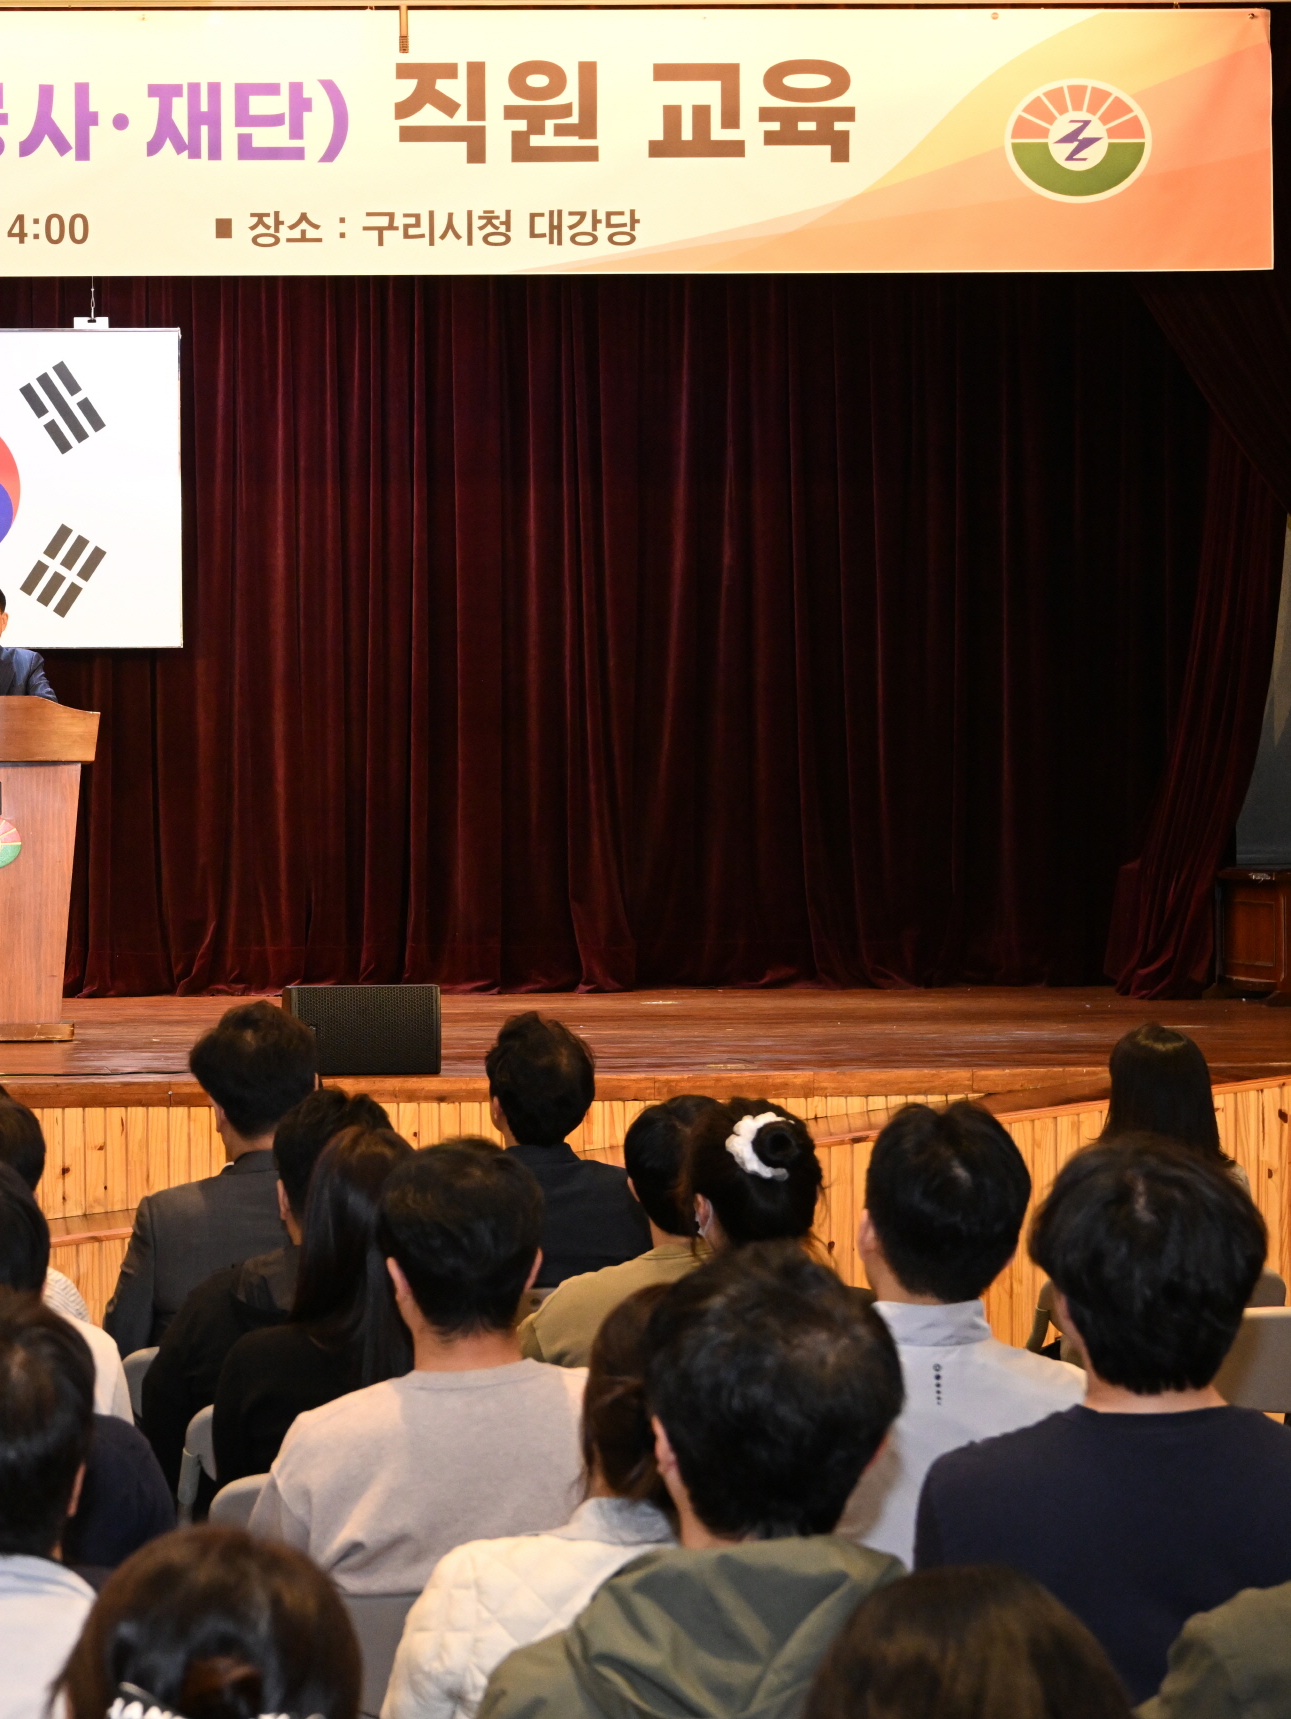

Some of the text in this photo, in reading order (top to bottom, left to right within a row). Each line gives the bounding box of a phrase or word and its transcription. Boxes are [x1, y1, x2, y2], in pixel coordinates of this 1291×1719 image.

[395, 60, 599, 164] 직원
[648, 59, 856, 163] 교육
[248, 210, 323, 247] 장소
[362, 209, 512, 246] 구리시청
[529, 208, 641, 246] 대강당
